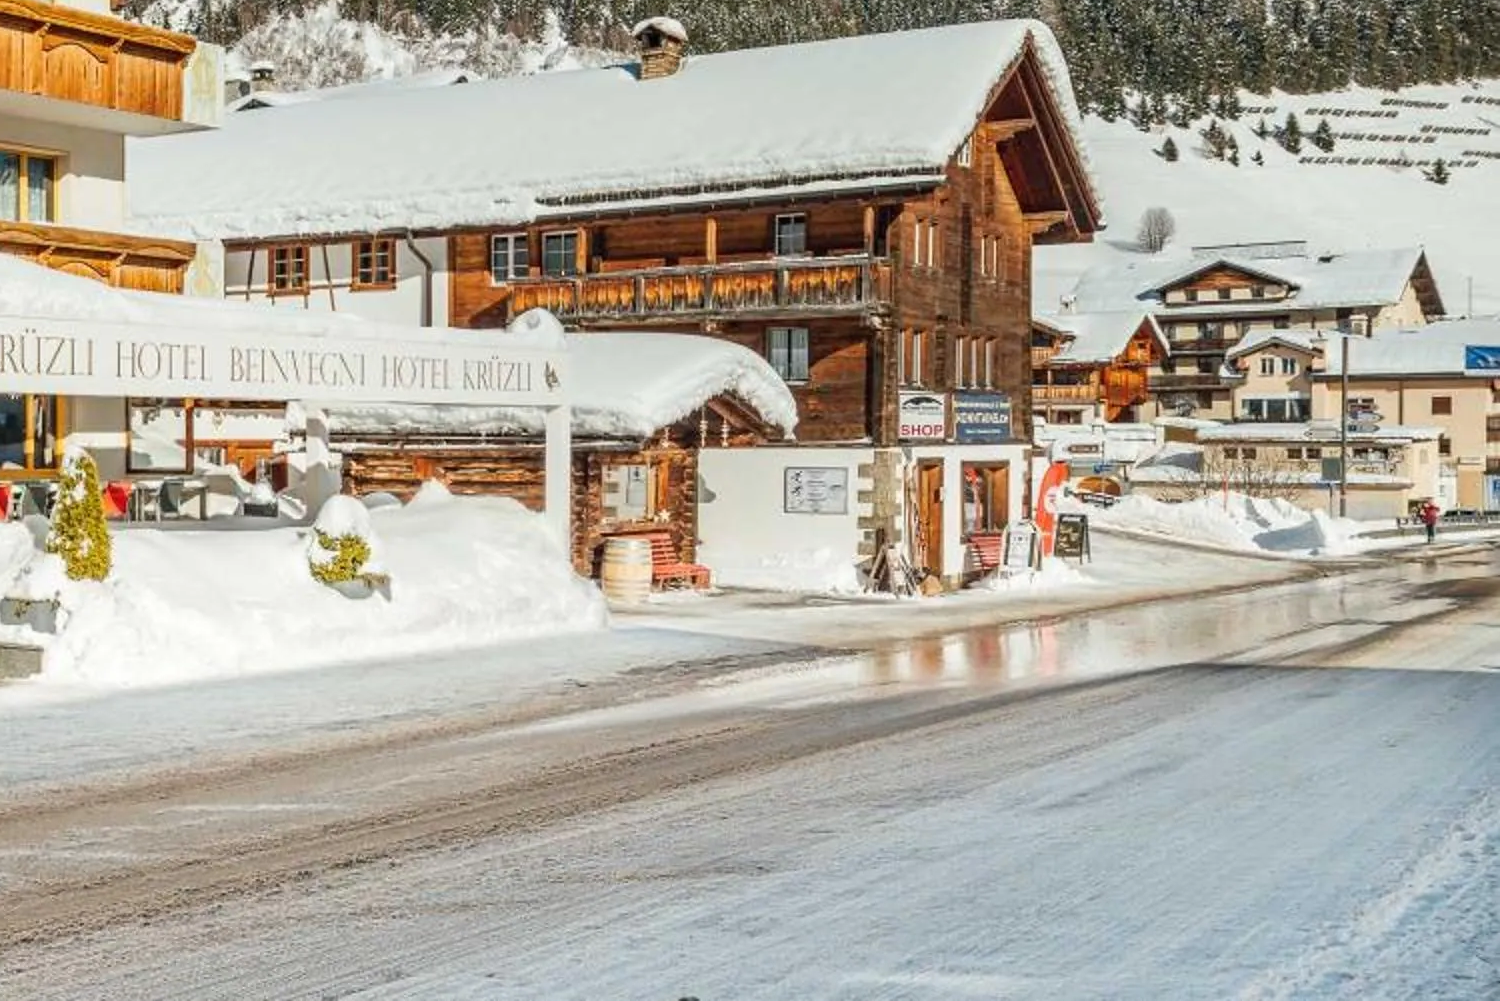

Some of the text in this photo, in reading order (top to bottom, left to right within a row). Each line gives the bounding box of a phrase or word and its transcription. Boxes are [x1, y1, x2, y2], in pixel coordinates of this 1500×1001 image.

[116, 341, 212, 381] HOTEL
[230, 346, 366, 387] BEINVEGNI
[381, 353, 451, 390] HOTEL
[462, 355, 531, 392] KRÜZLI
[901, 424, 943, 436] SHOP
